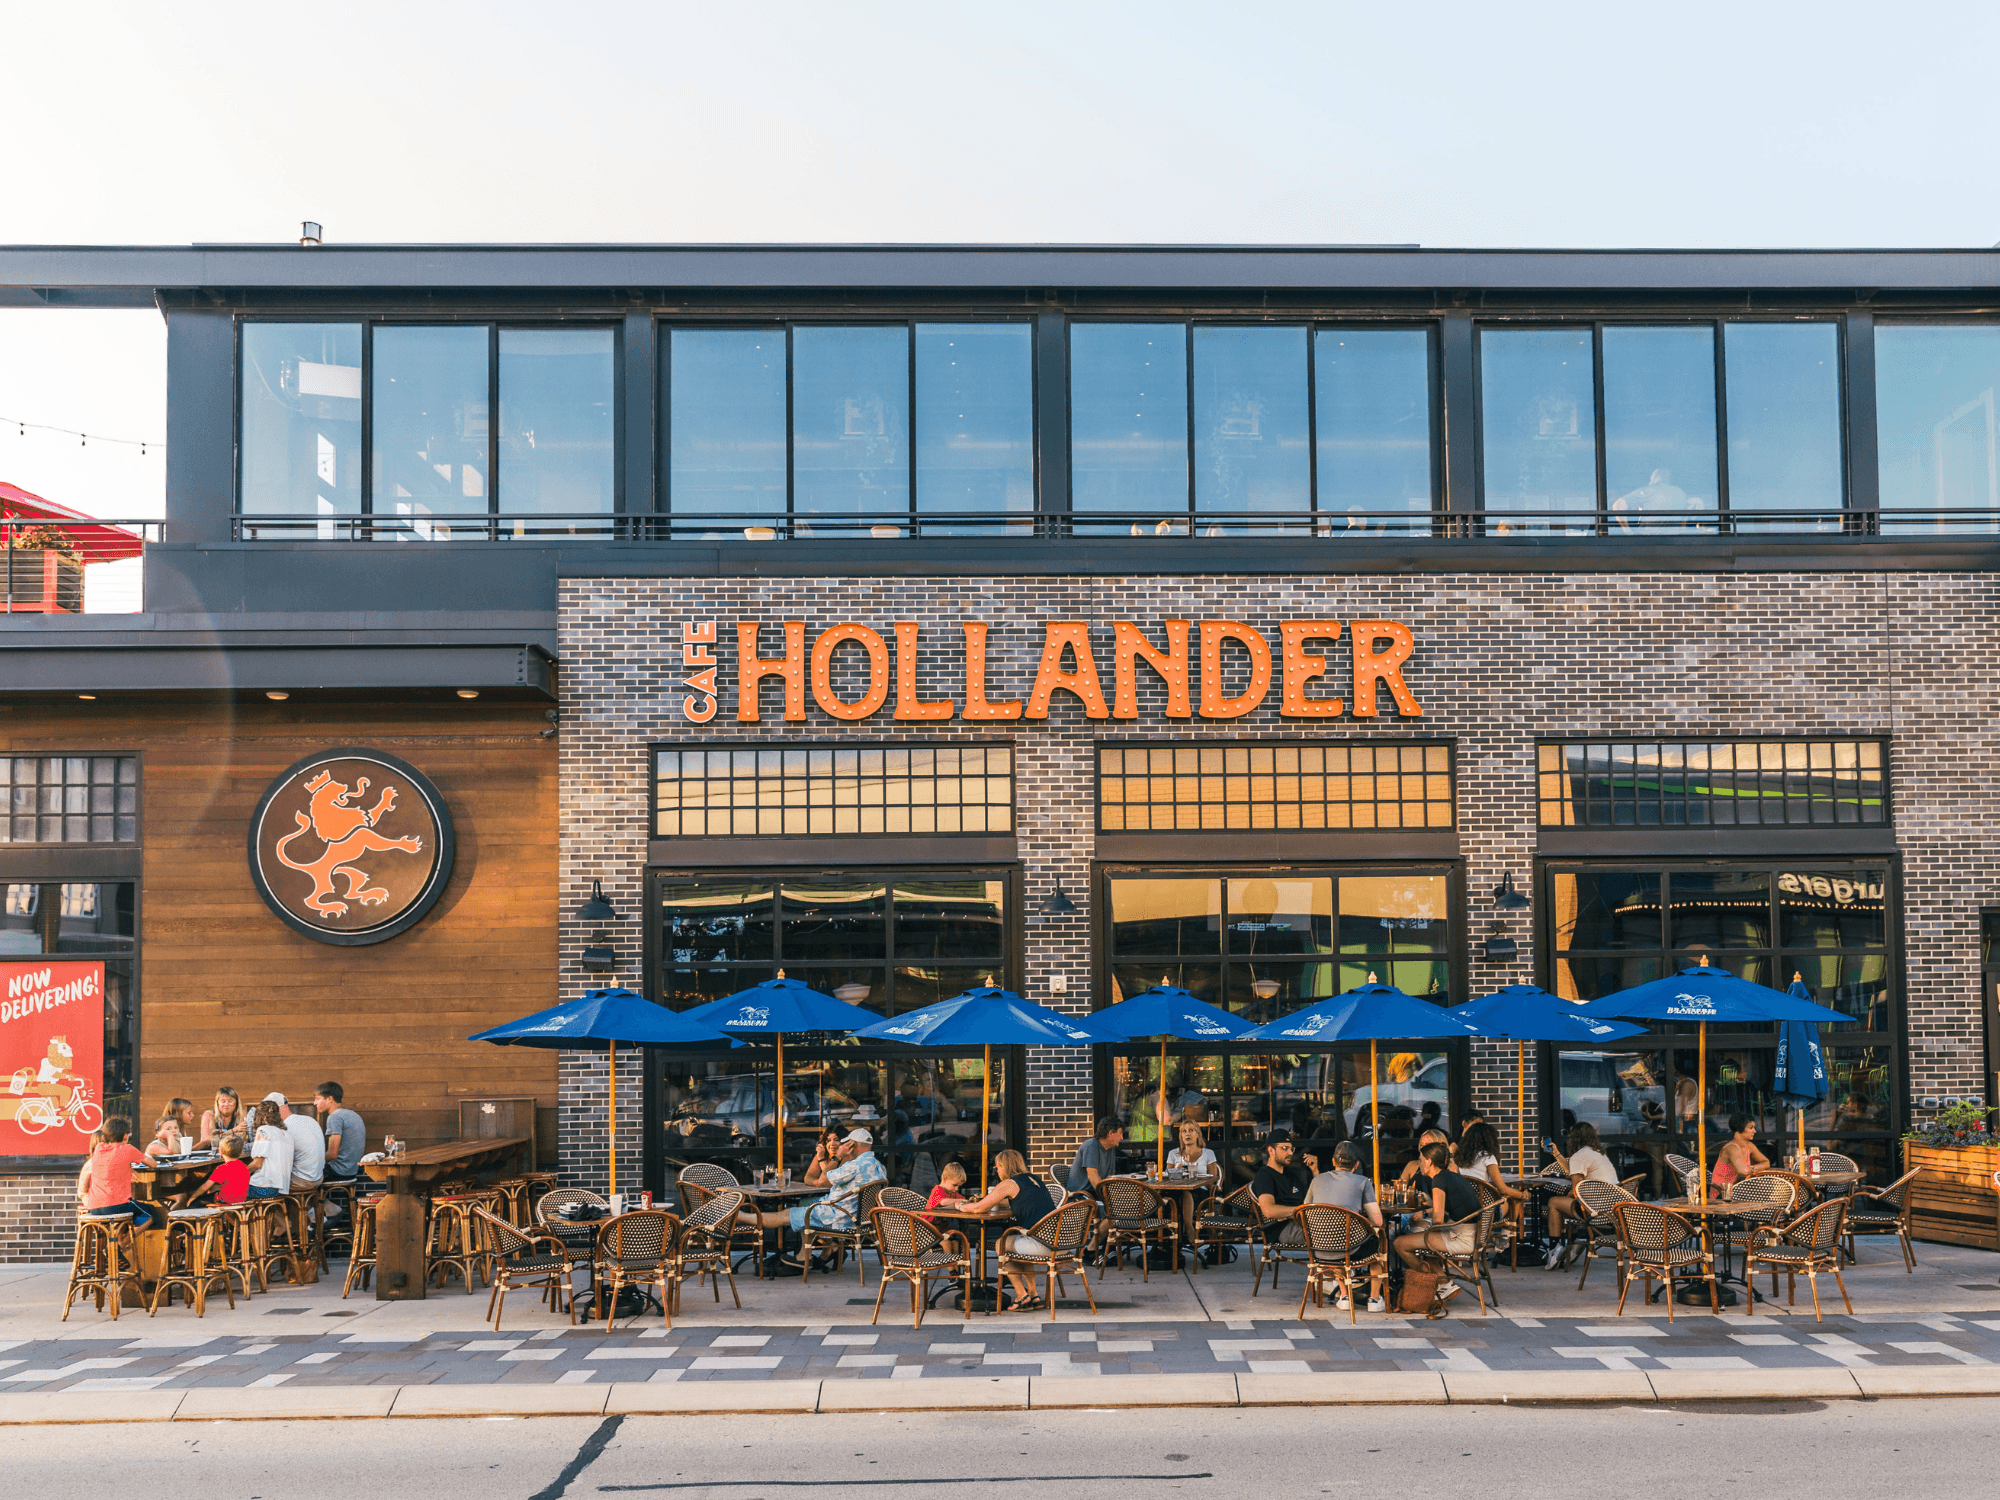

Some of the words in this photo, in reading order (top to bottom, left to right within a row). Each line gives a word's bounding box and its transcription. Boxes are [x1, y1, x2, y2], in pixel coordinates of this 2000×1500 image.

[682, 620, 718, 724] CAFE
[736, 619, 1423, 722] HOLLANDER
[0, 969, 100, 1024] DELIVERING!
[8, 967, 52, 998] NOW
